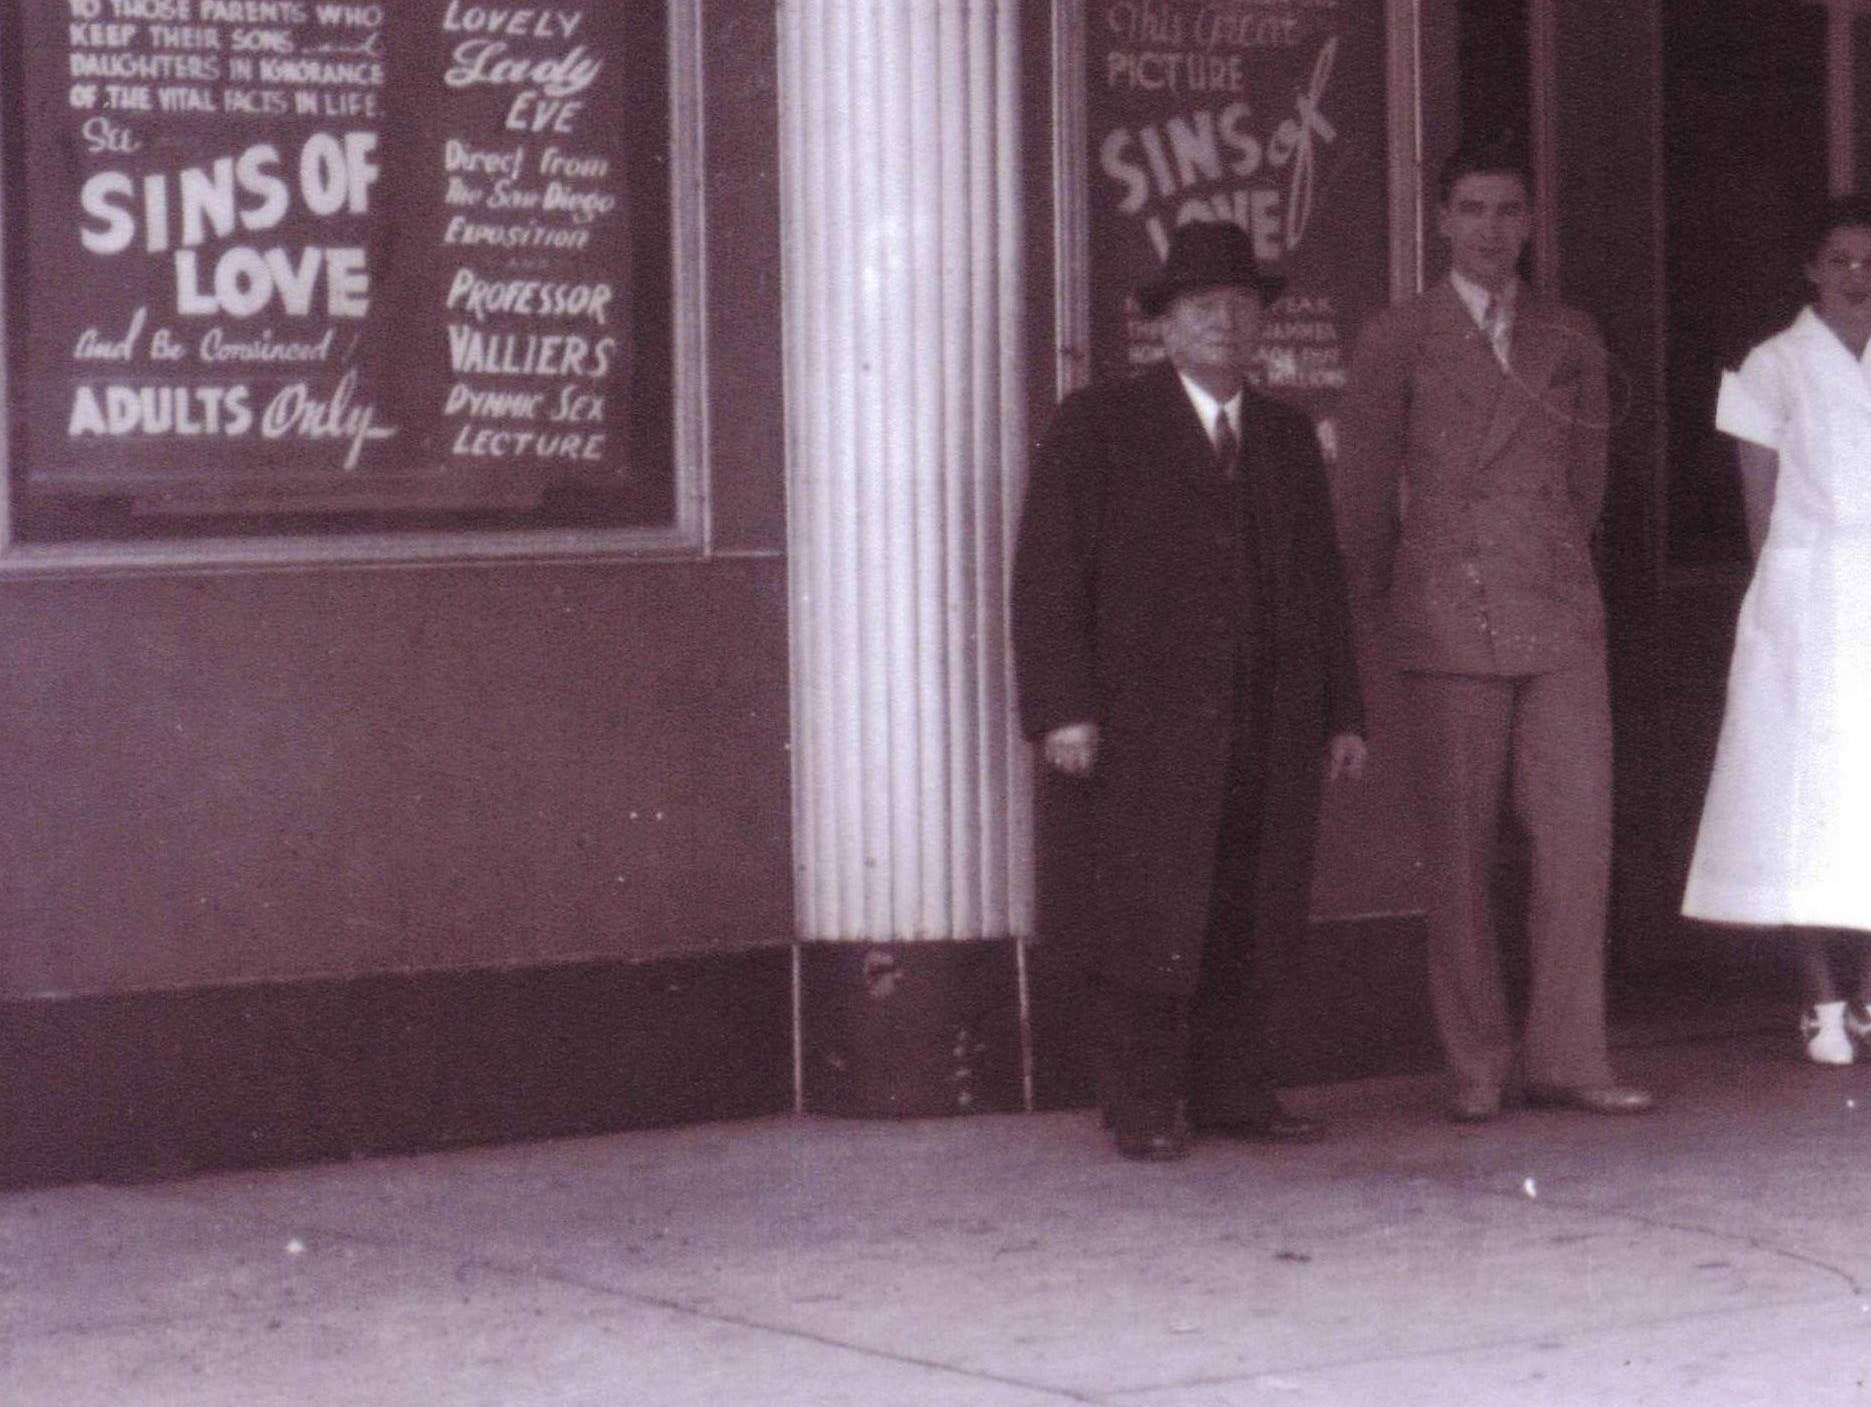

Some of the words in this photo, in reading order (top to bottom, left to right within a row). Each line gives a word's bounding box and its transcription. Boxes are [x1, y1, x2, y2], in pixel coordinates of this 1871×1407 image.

[68, 22, 137, 48] KEEP
[148, 24, 221, 51] THEIR
[230, 27, 294, 54] SONS
[315, 3, 383, 28] WHO
[68, 52, 221, 81] DAUGHTERS
[229, 55, 253, 81] IN
[259, 57, 385, 85] IGNORANCE
[443, 38, 602, 99] Lady
[1106, 51, 1245, 94] PICTURE
[68, 82, 98, 109] OF
[107, 83, 151, 110] THE
[157, 87, 216, 113] VITAL
[223, 88, 287, 115] FACTS
[295, 89, 318, 116] IN
[504, 89, 584, 134] EVE
[1100, 102, 1262, 214] SINS
[80, 143, 291, 256] SINS
[300, 130, 380, 217] OF
[542, 181, 617, 224] Diego
[174, 245, 372, 318] LOVE
[446, 267, 613, 324] PROFESSOR
[447, 324, 616, 378] VALLIERS
[67, 384, 253, 437] ADULTS
[260, 368, 398, 471] Only
[452, 423, 605, 461] LECTURE
